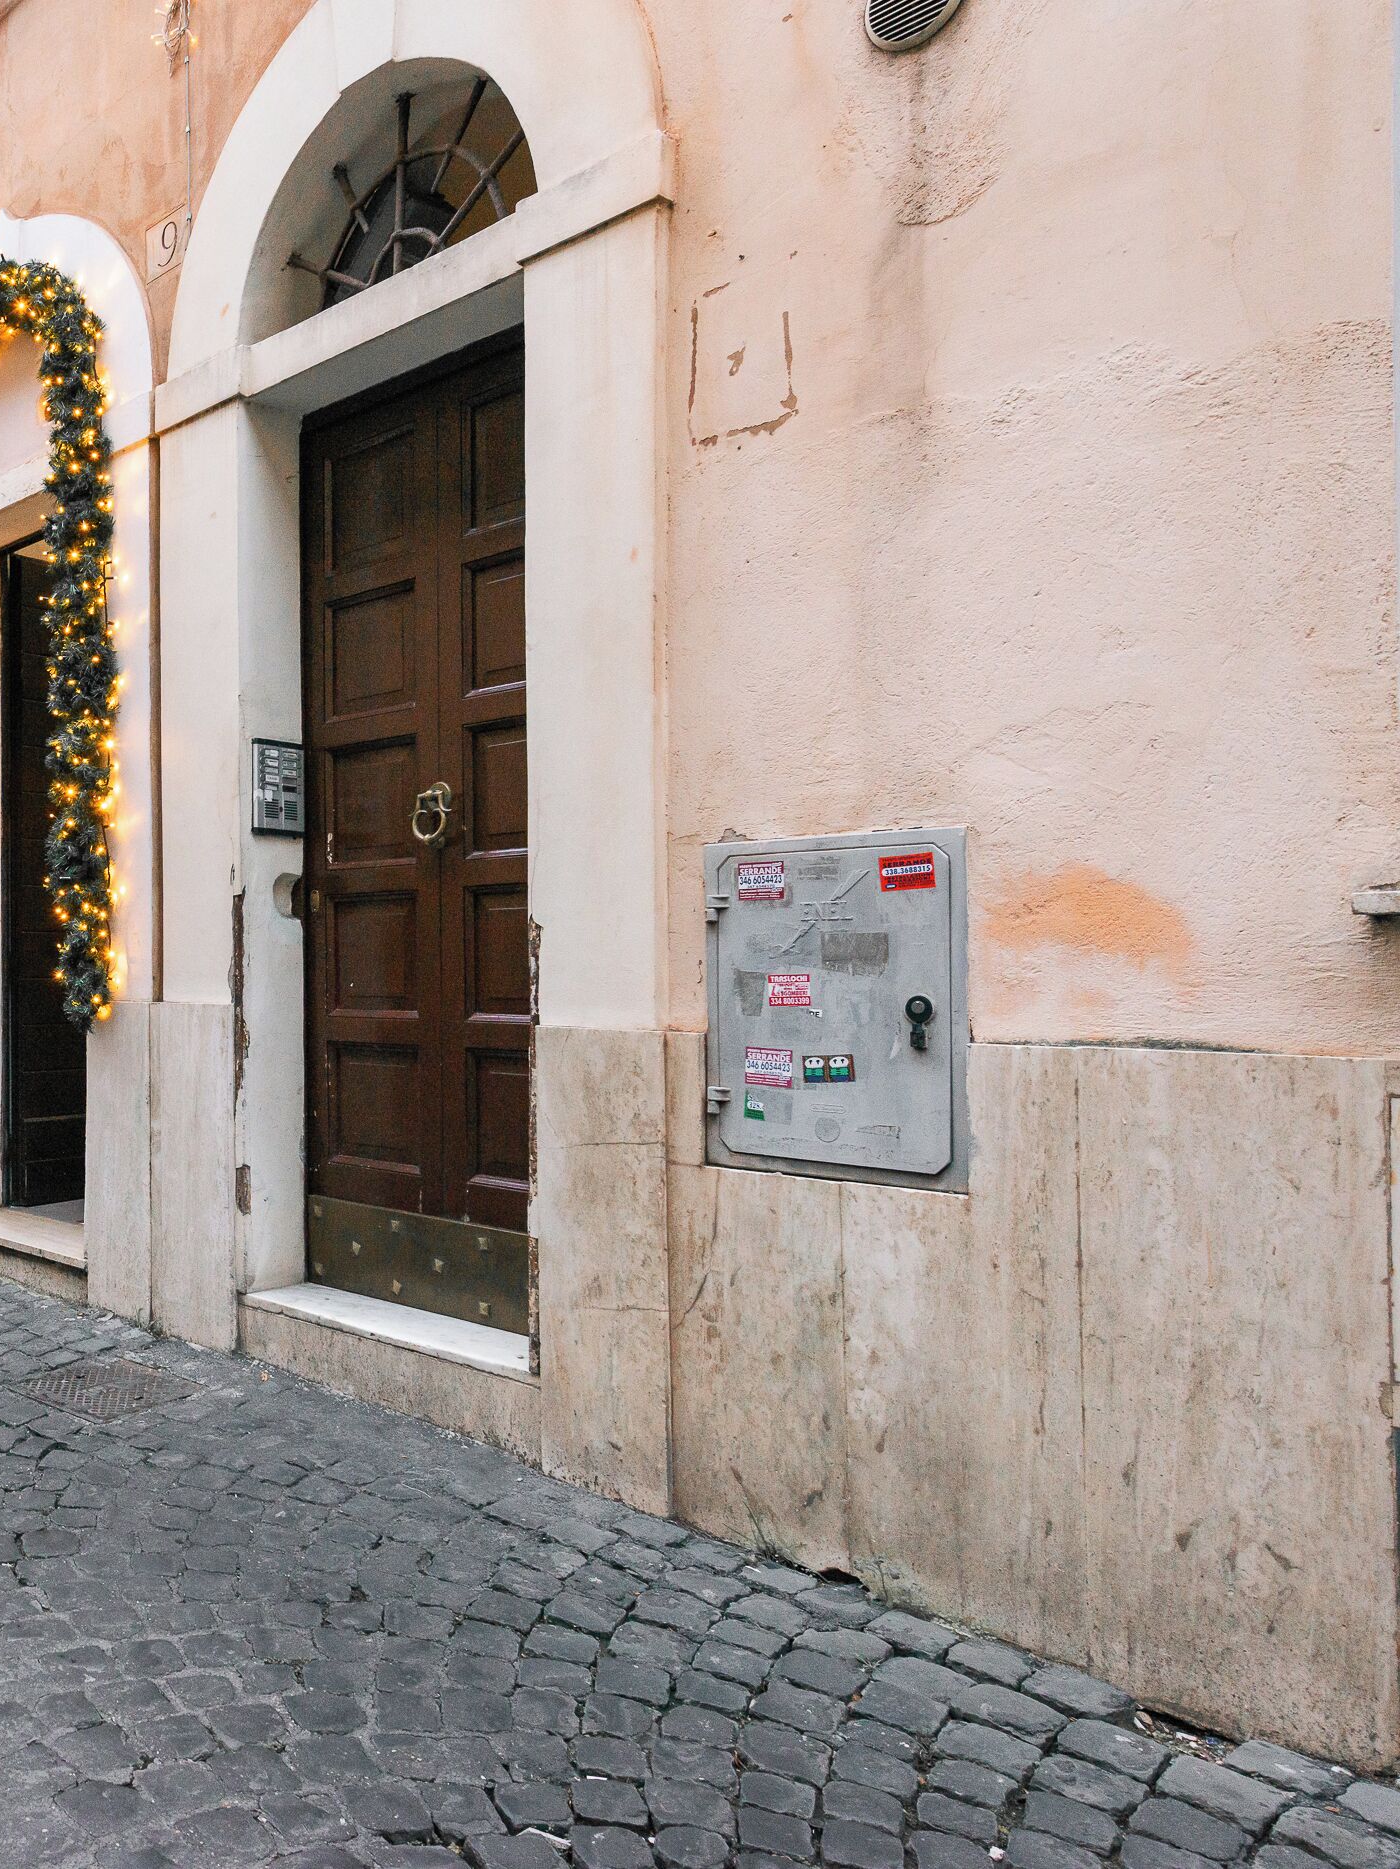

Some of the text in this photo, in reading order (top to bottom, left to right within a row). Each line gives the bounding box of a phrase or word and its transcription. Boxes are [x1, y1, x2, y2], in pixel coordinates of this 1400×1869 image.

[157, 221, 178, 267] 9
[883, 858, 932, 868] SERRANDE
[739, 867, 782, 876] SERRANDE
[740, 875, 783, 885] 346 6054423
[800, 900, 854, 921] ENEL
[747, 1052, 791, 1063] SERRANDE
[747, 1060, 791, 1072] 346 6054423
